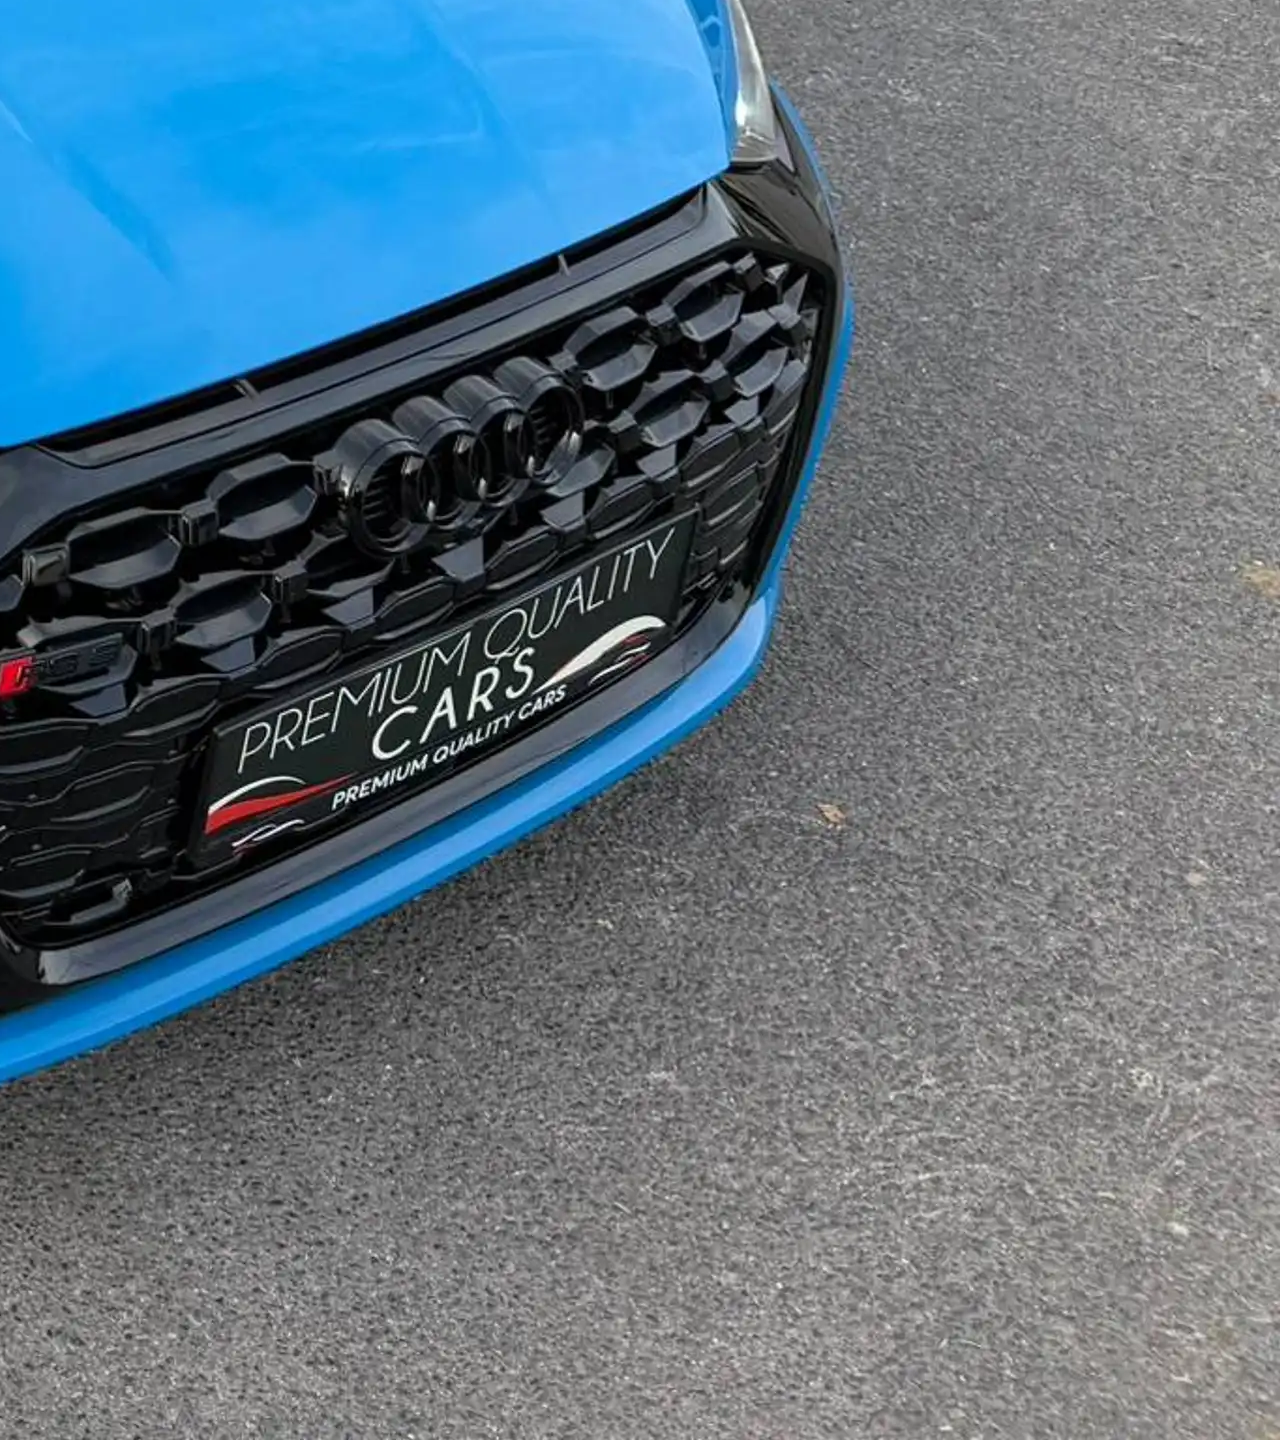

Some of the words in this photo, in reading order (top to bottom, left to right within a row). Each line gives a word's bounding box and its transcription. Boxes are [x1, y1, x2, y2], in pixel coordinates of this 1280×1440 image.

[238, 630, 472, 774] PREMIUM
[483, 526, 676, 660] QUALITY
[371, 646, 537, 761] CARS
[330, 754, 429, 811] PREMIUM
[432, 711, 516, 765] QUALITY
[518, 684, 567, 722] CARS
